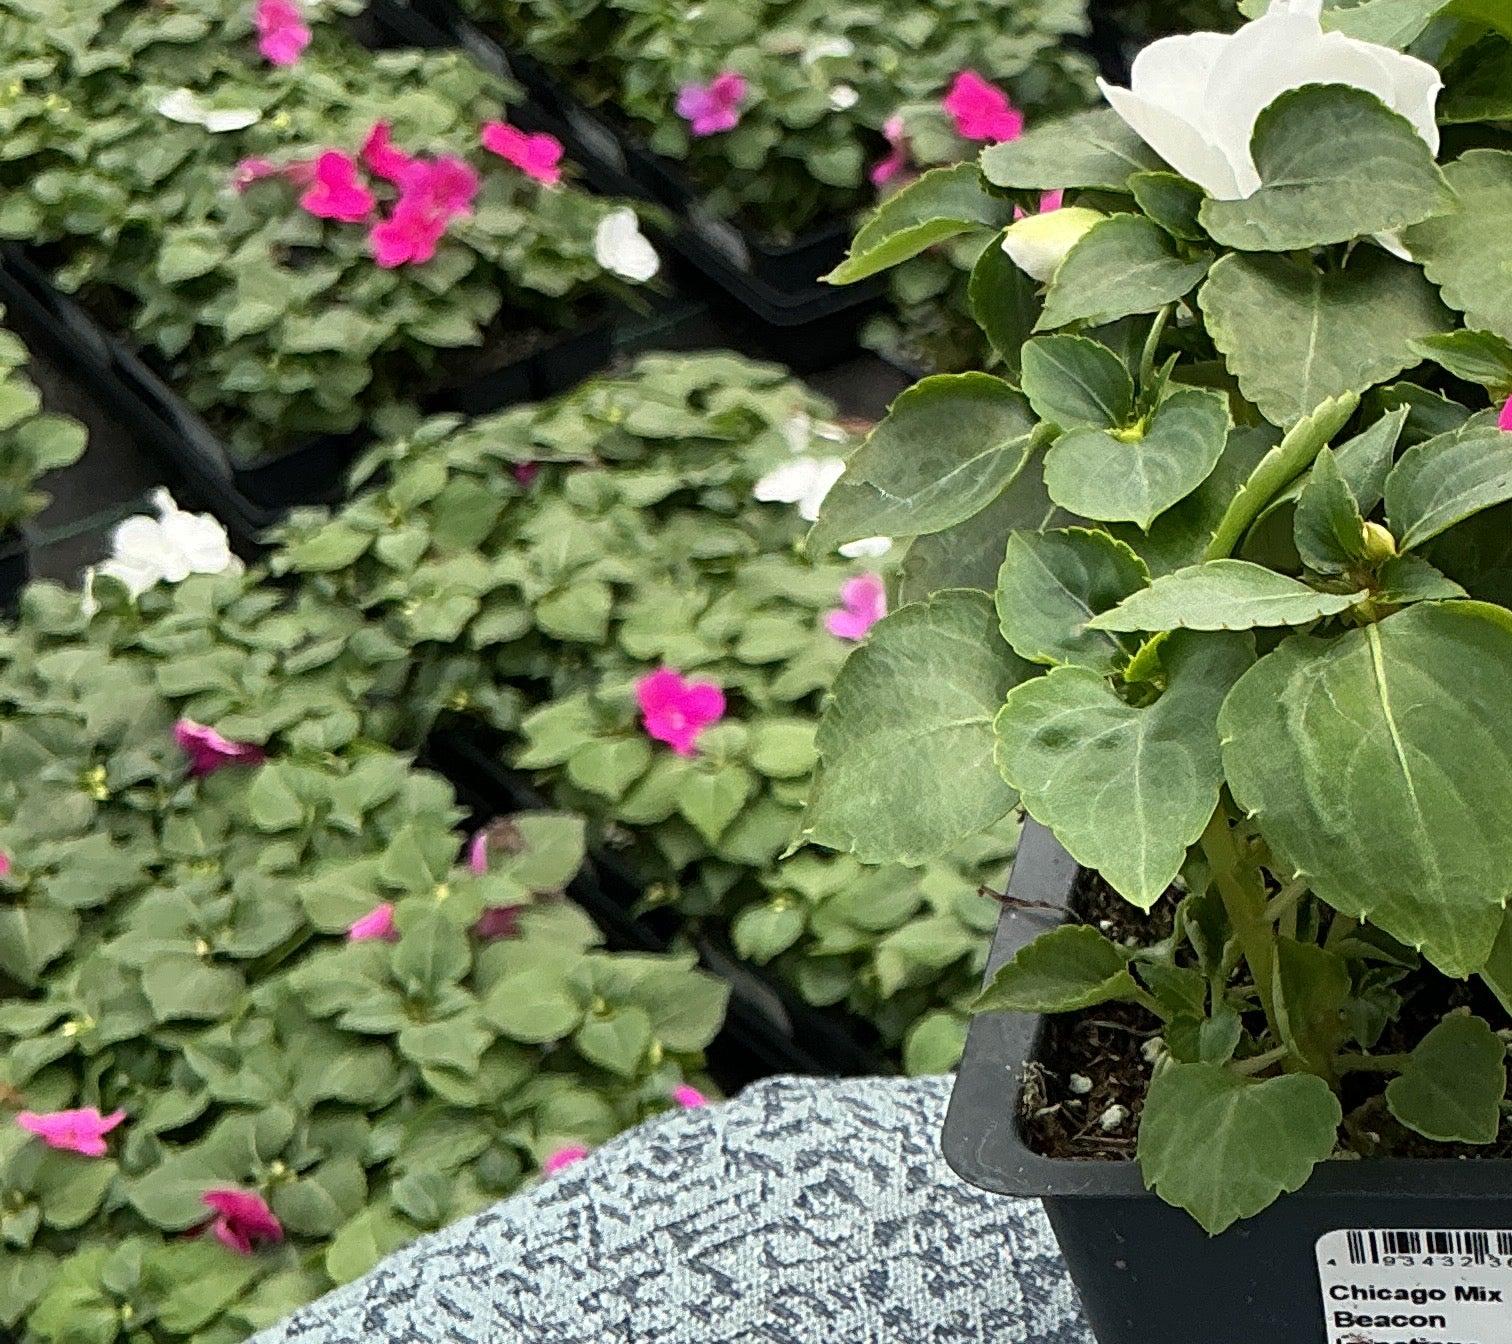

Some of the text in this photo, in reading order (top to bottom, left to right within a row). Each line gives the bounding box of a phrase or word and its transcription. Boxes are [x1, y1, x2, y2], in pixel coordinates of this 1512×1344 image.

[1329, 1285, 1503, 1304] Chicago Mix
[1334, 1311, 1446, 1327] Beacon
